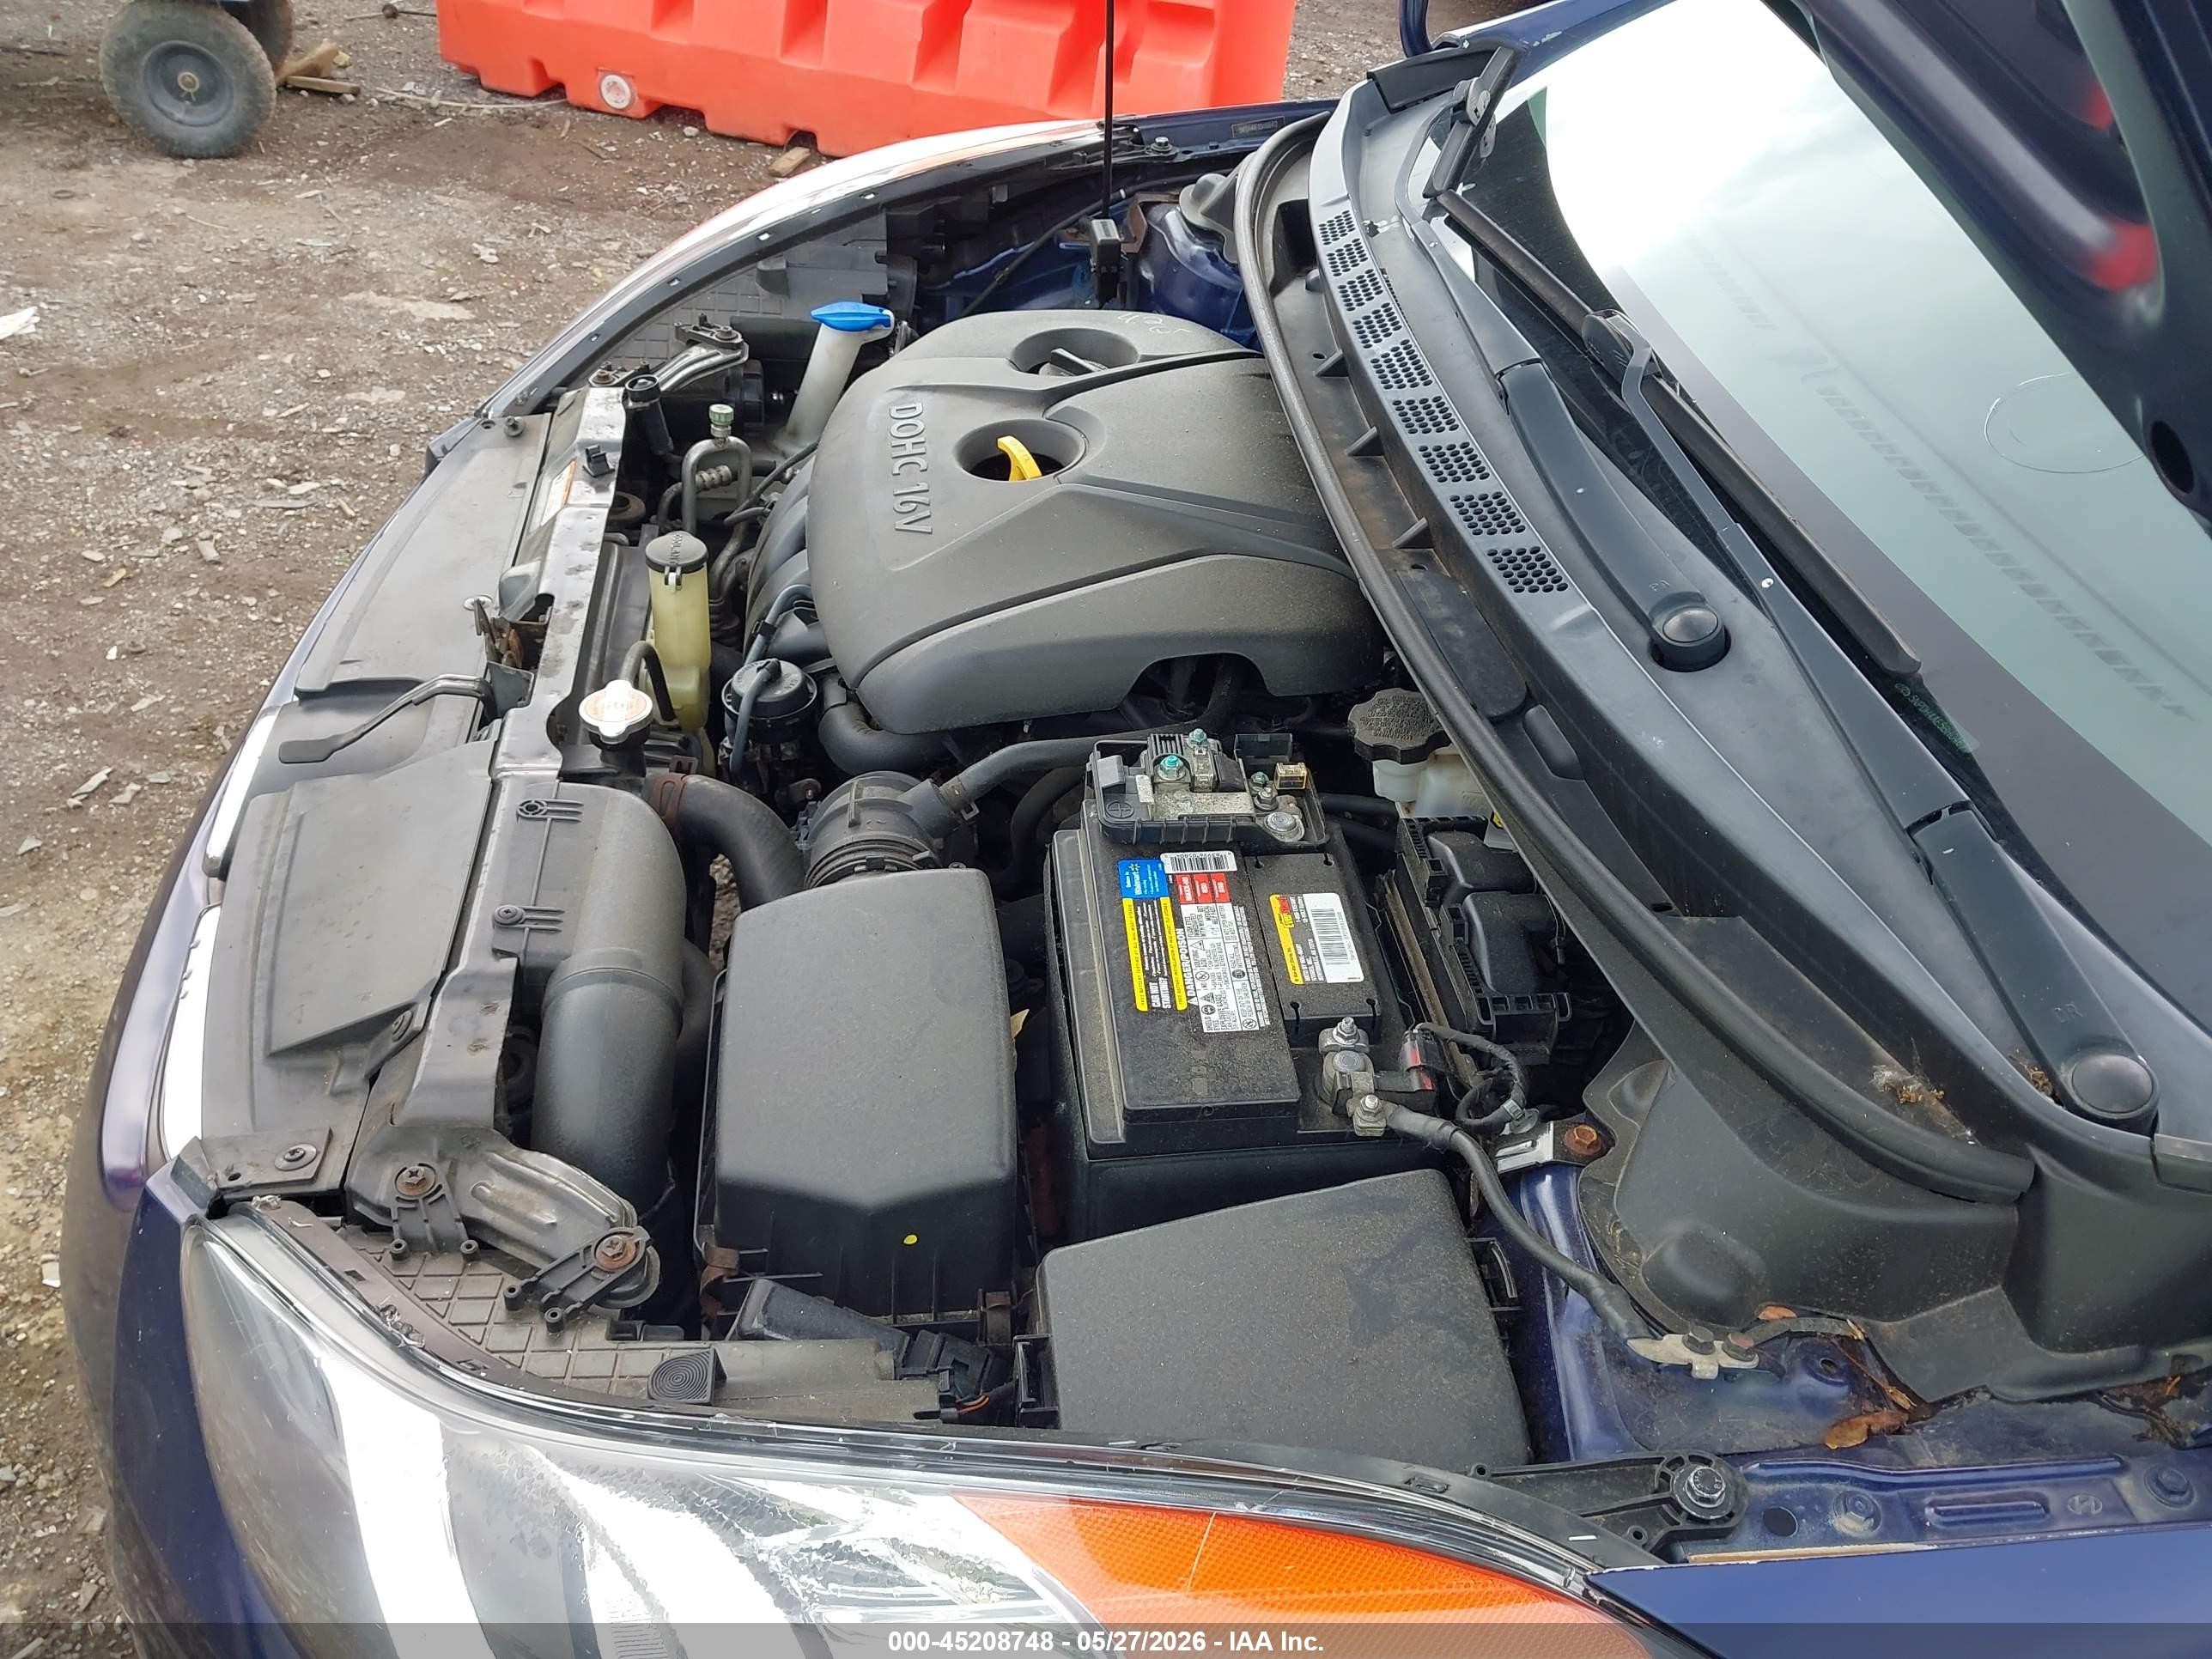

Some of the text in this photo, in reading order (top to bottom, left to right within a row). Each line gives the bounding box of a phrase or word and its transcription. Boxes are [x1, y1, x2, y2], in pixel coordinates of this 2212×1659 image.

[888, 402, 933, 535] DOHC 16V
[1131, 871, 1142, 895] Walmart
[1148, 981, 1159, 994] NOT
[1157, 976, 1171, 1008] STARTING?
[1150, 994, 1161, 1007] CAR
